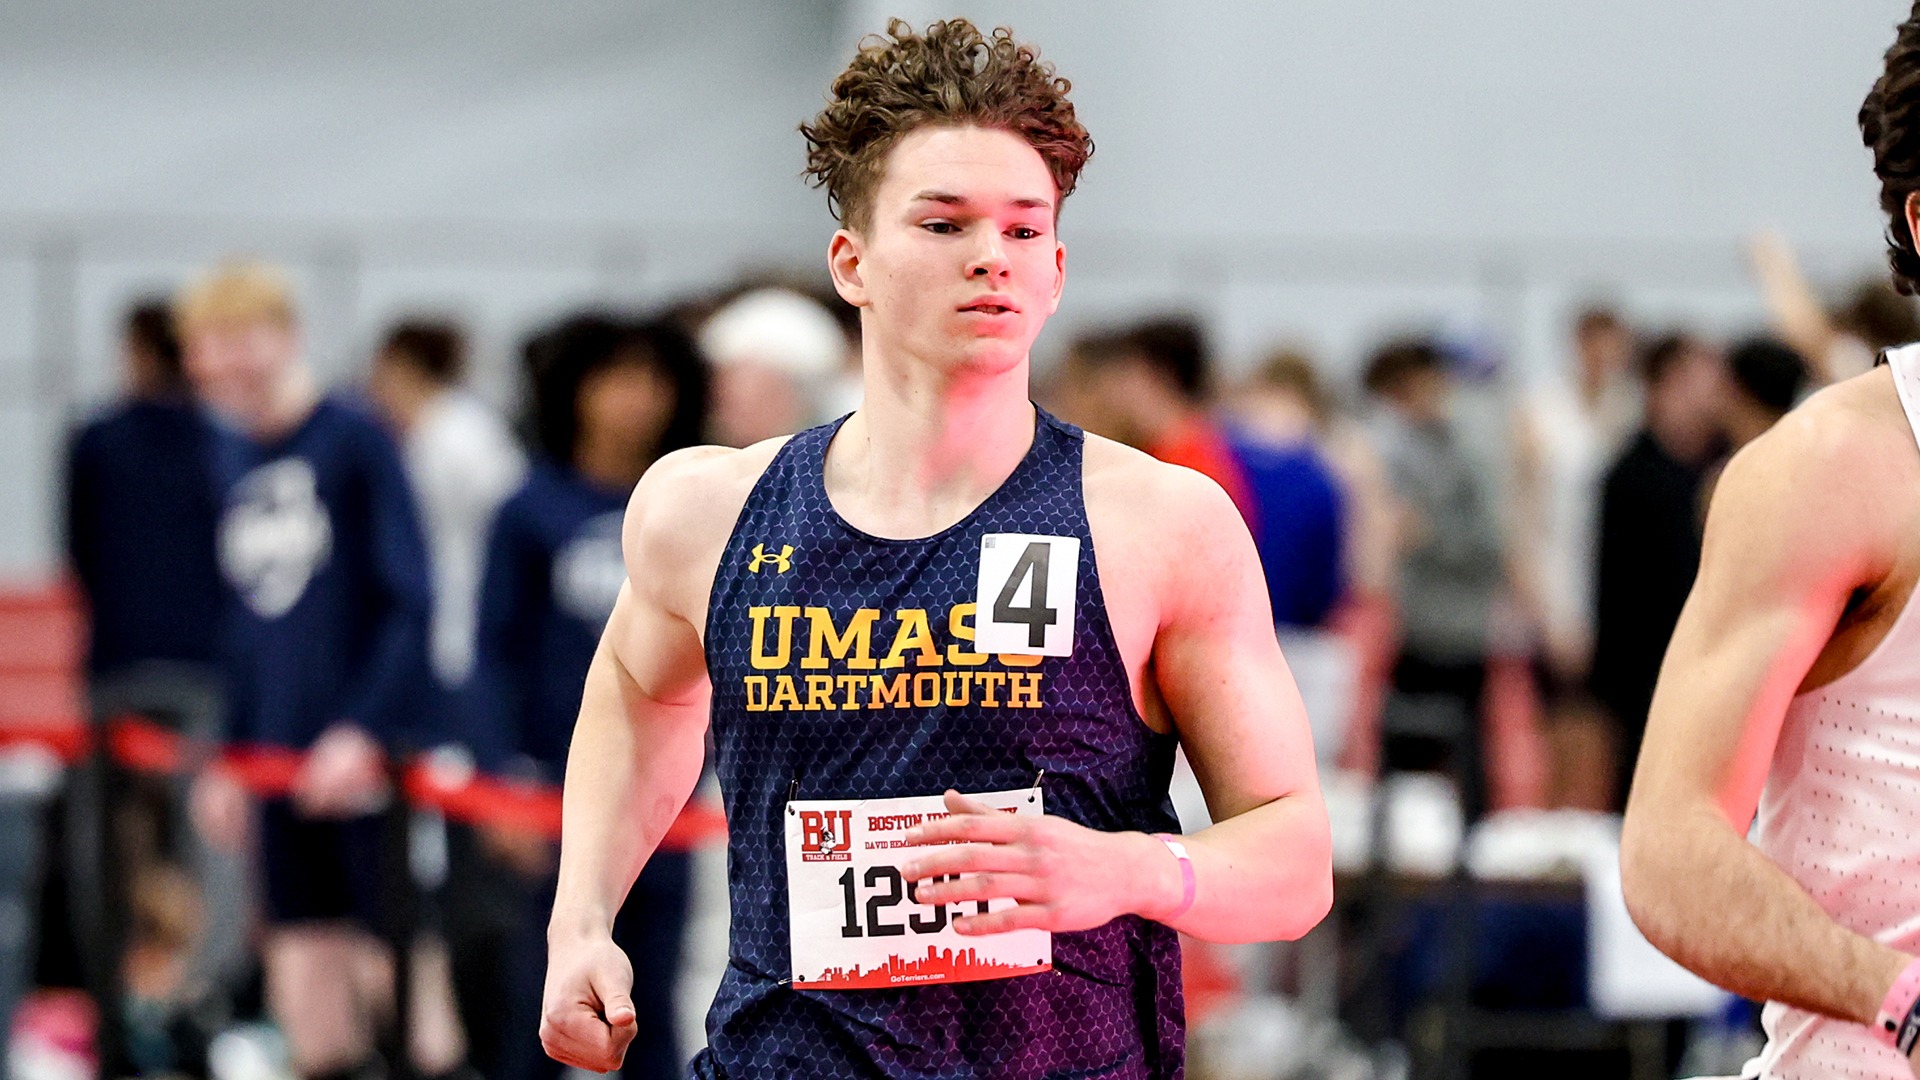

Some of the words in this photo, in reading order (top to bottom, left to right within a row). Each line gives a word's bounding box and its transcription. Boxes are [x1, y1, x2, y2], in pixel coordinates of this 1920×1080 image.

[993, 542, 1057, 648] 4
[749, 603, 1044, 669] UMAS
[743, 672, 1043, 711] DARTMOUTH
[799, 810, 852, 852] BU
[868, 814, 923, 831] BOSTON
[831, 853, 848, 861] FIELD
[864, 840, 889, 850] DAVID
